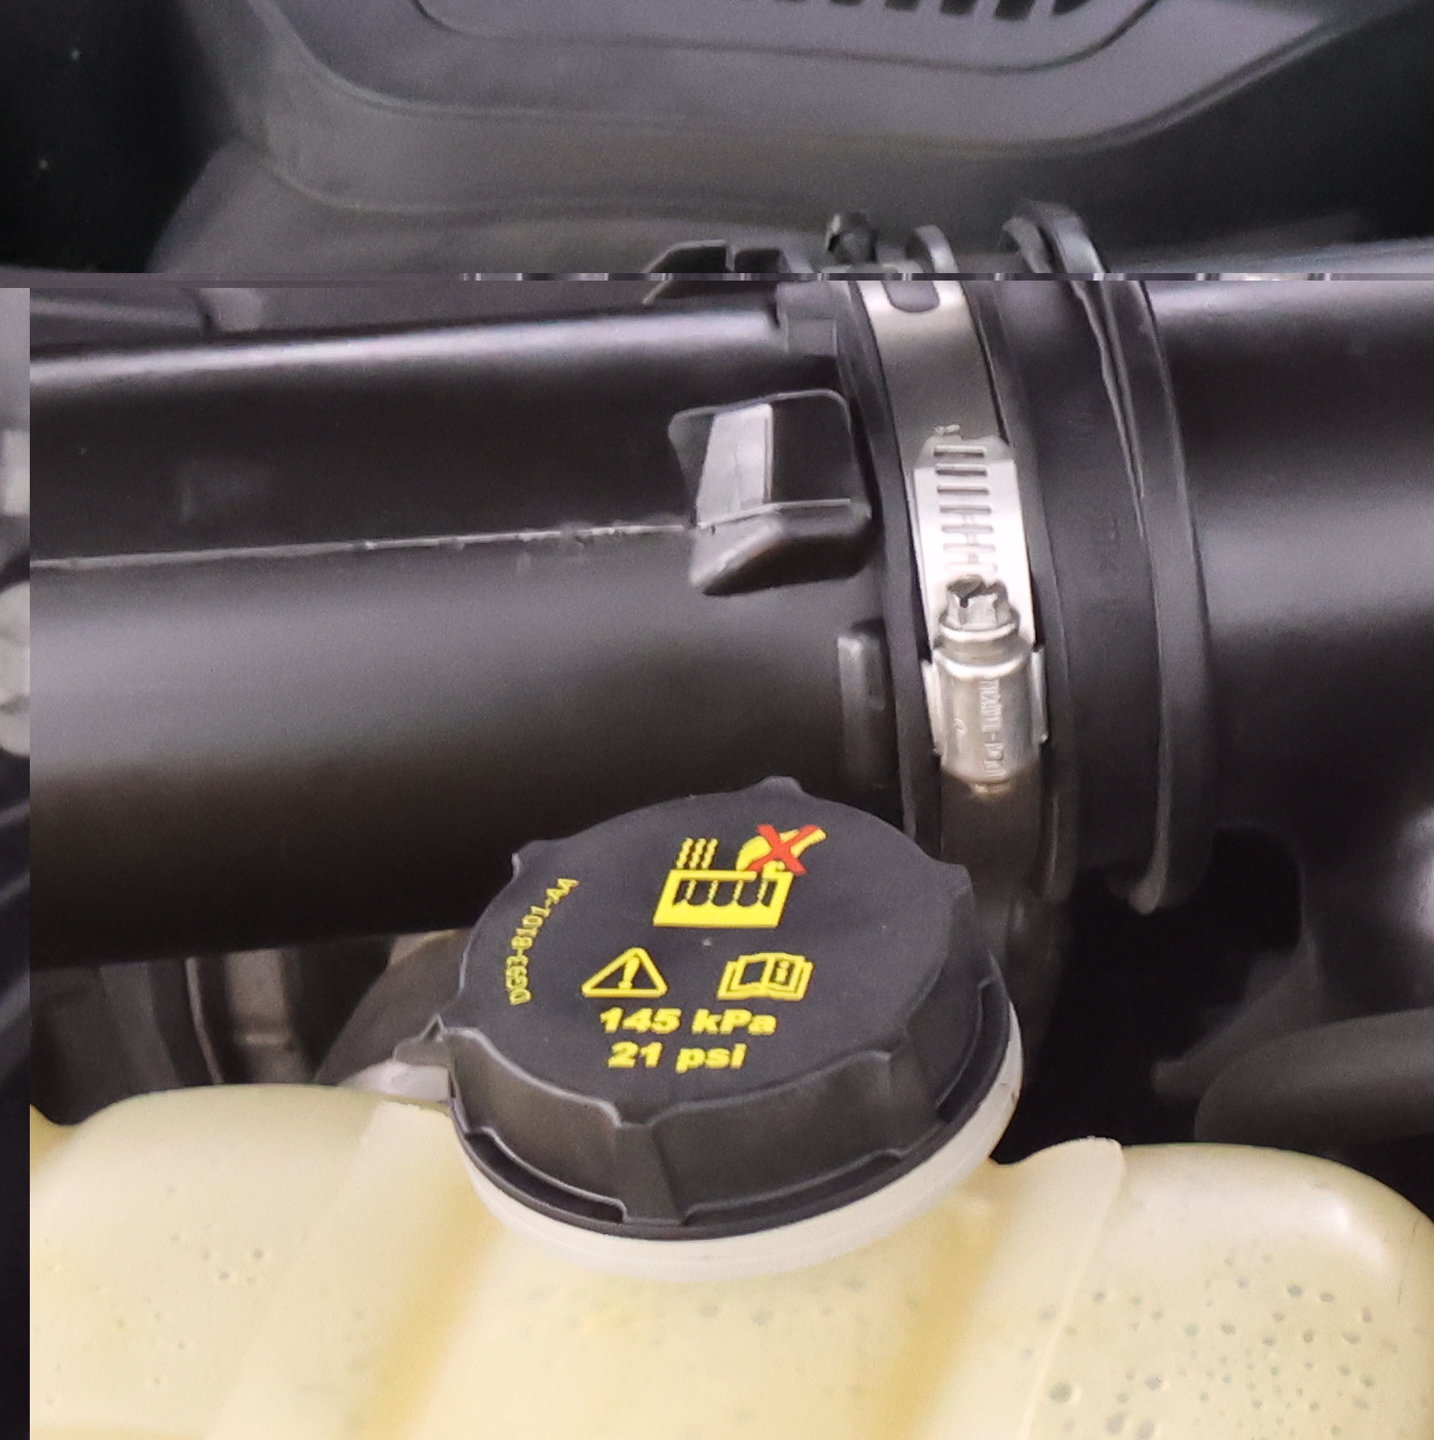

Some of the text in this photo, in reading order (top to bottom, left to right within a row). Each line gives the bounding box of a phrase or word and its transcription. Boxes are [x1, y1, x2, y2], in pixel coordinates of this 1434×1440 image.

[599, 1006, 777, 1035] 145 kPa
[608, 1040, 747, 1074] 21 psi
